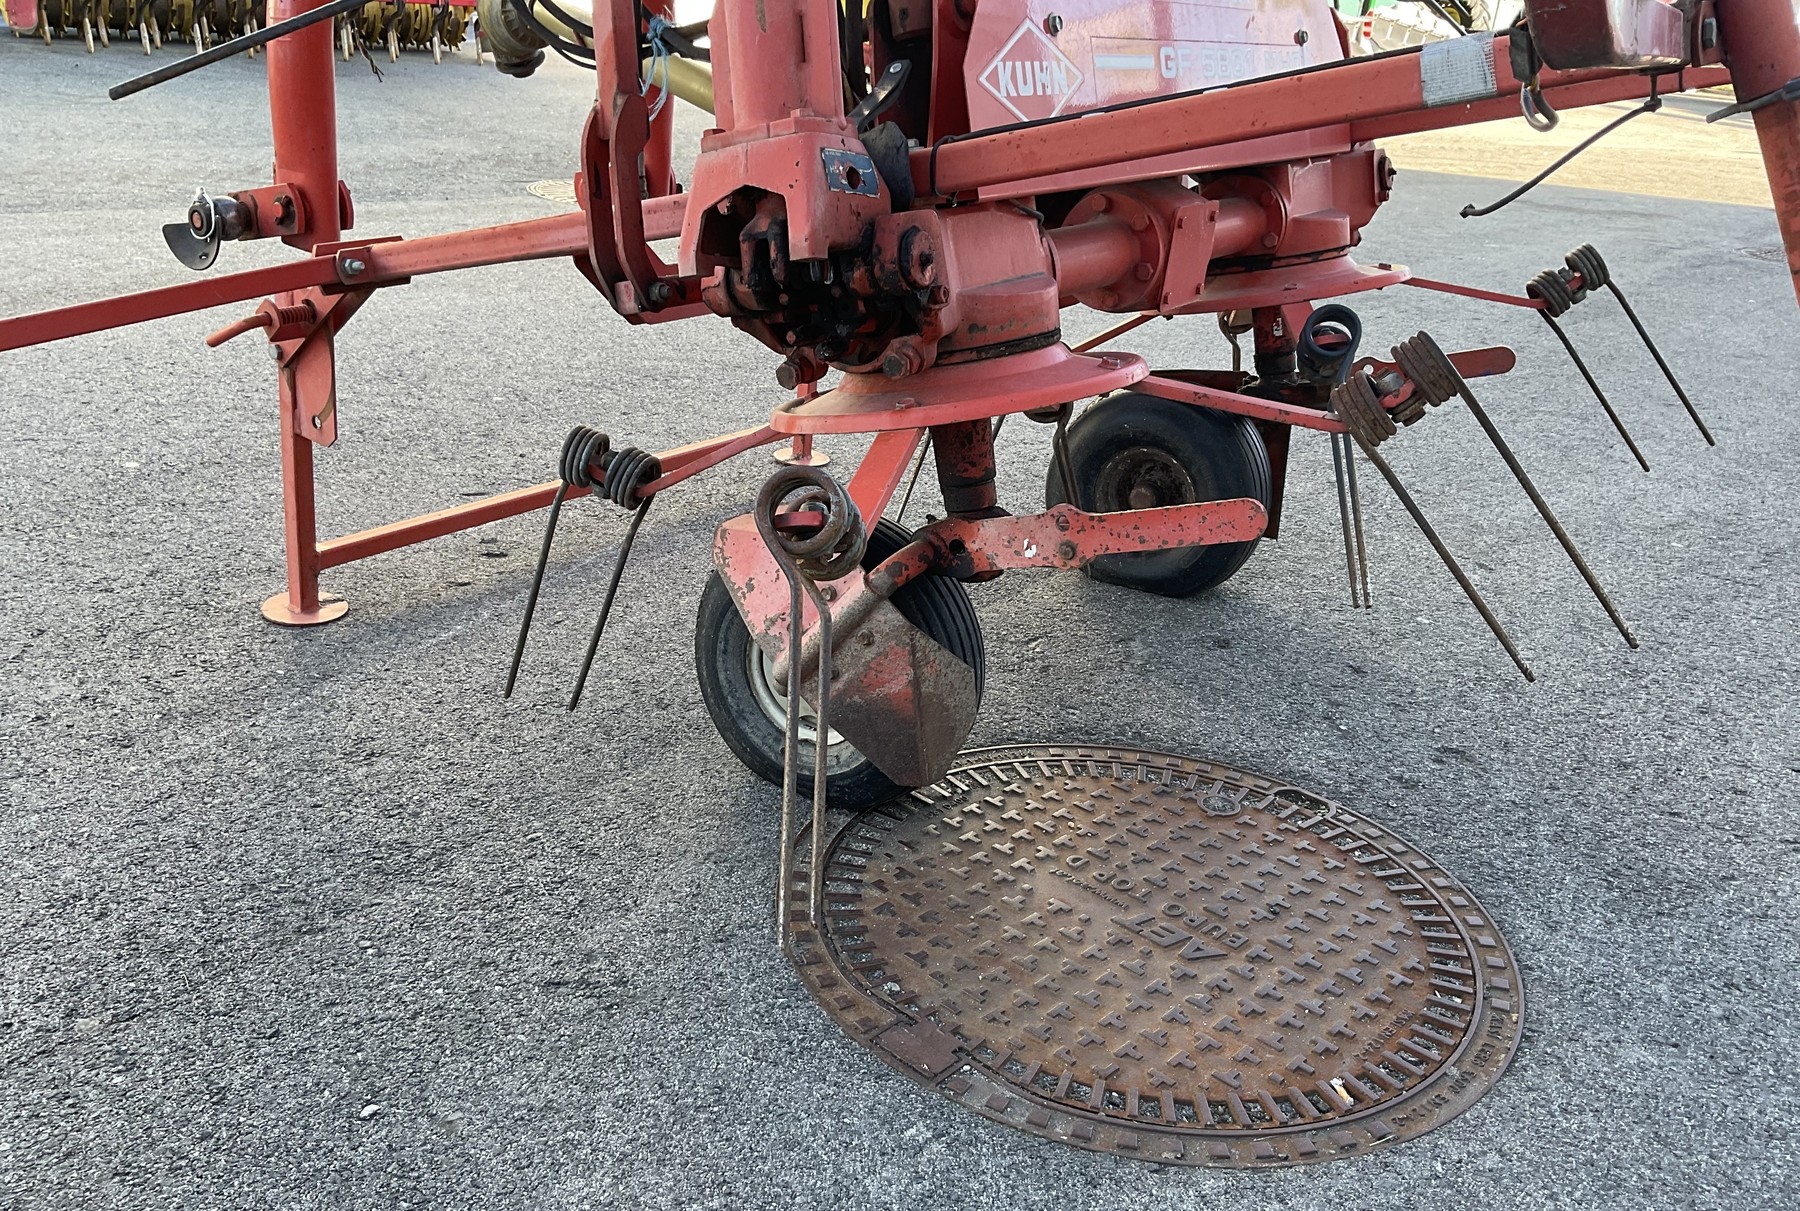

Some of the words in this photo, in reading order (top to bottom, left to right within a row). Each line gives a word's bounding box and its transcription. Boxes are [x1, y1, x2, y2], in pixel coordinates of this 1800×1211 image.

[997, 60, 1069, 97] KUHN
[1160, 46, 1192, 79] GF
[1201, 48, 1256, 78] 5801
[1110, 911, 1228, 961] AET
